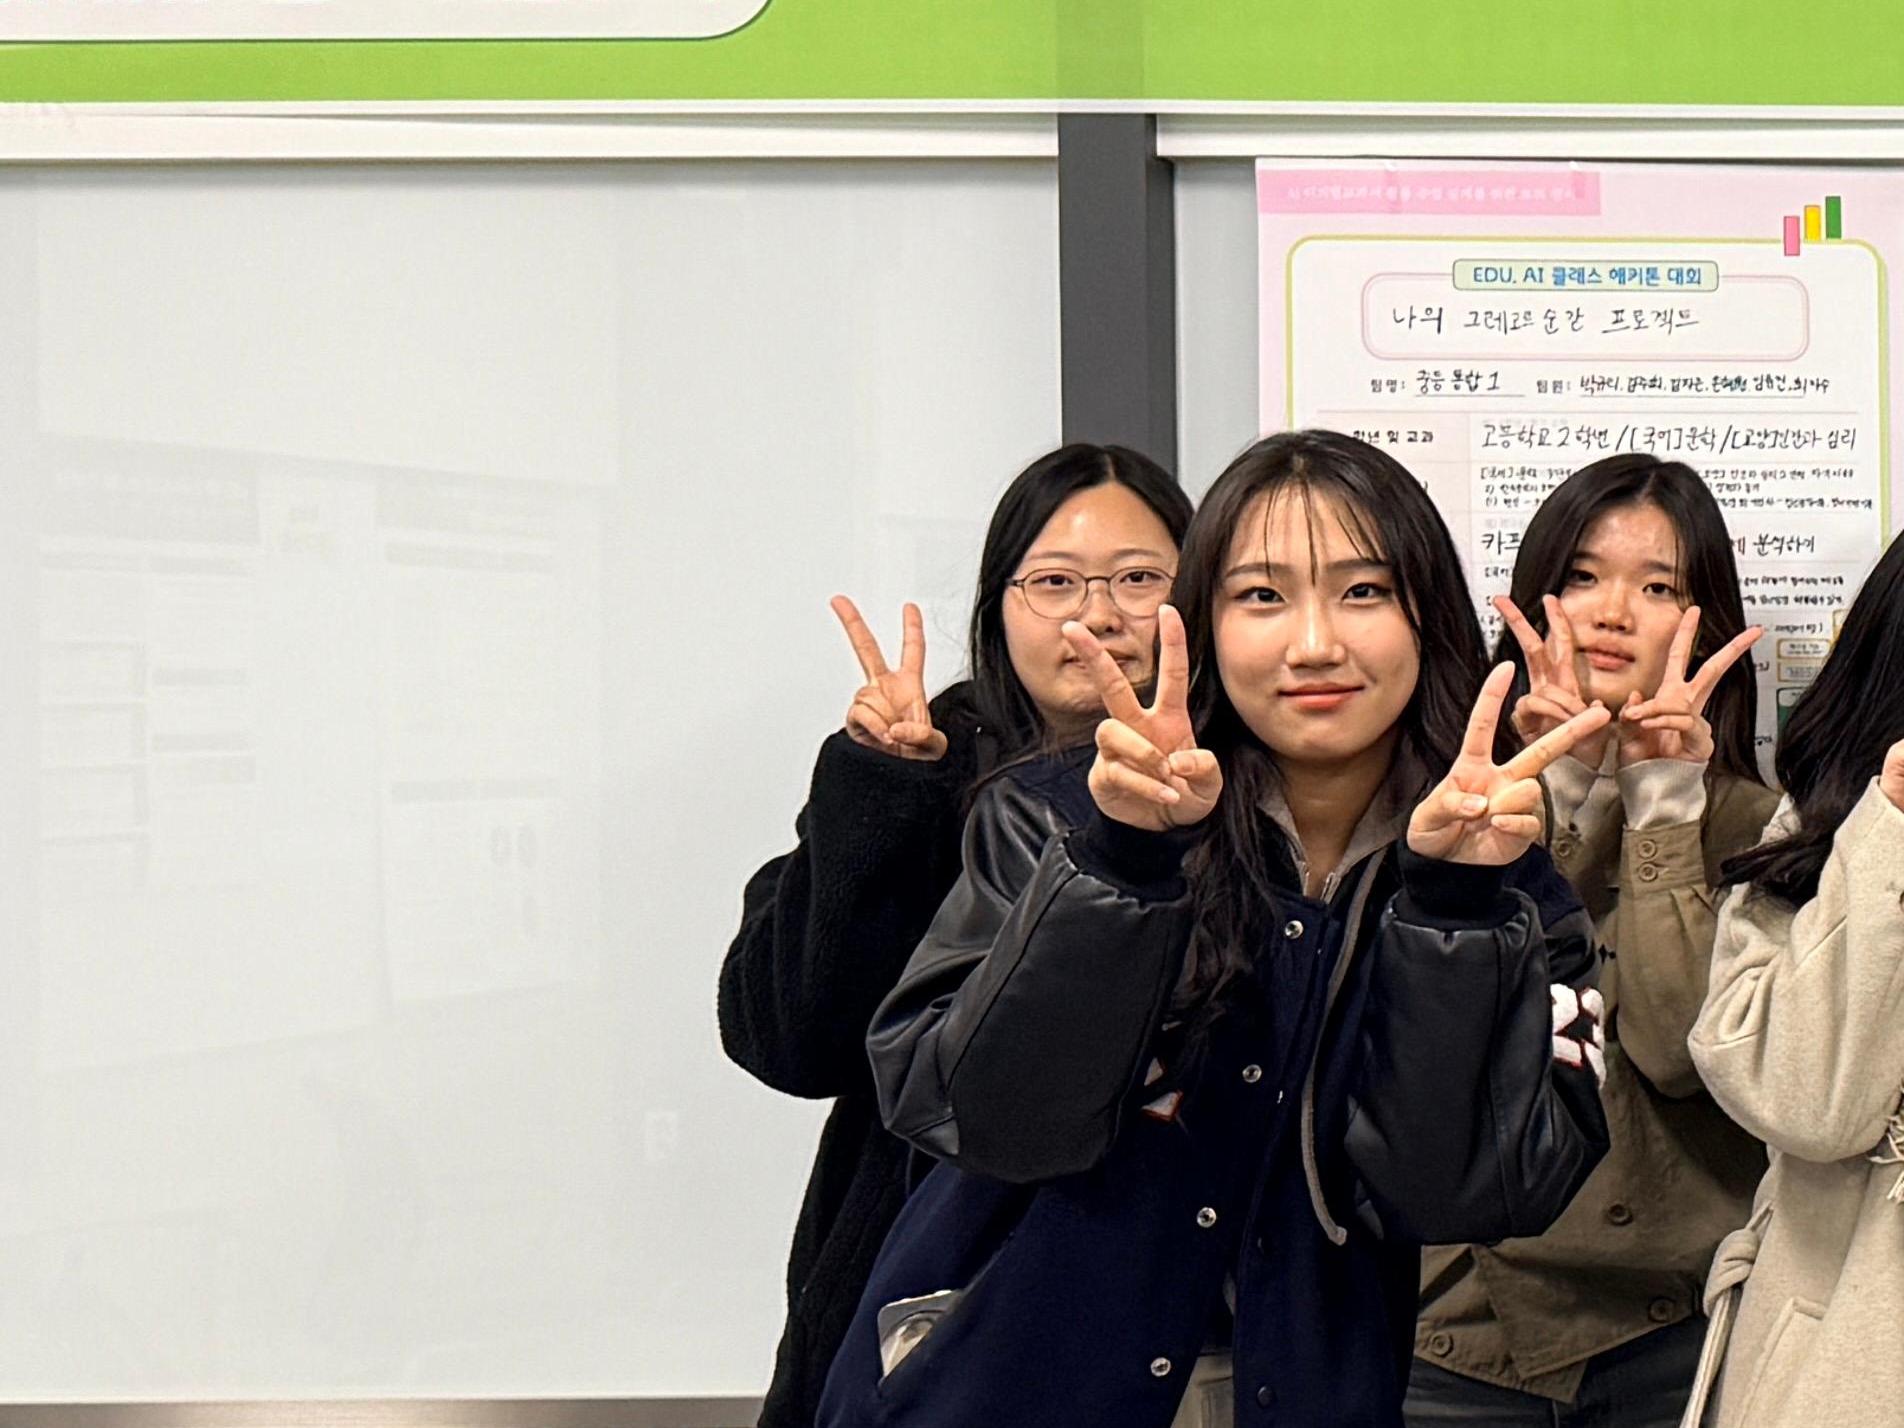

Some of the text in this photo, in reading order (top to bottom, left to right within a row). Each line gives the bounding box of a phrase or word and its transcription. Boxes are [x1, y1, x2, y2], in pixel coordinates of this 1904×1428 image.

[1523, 267, 1544, 283] AI
[1552, 267, 1602, 285] 클래스
[1393, 305, 1443, 335] 나의
[1752, 533, 1816, 557] 분석하기
